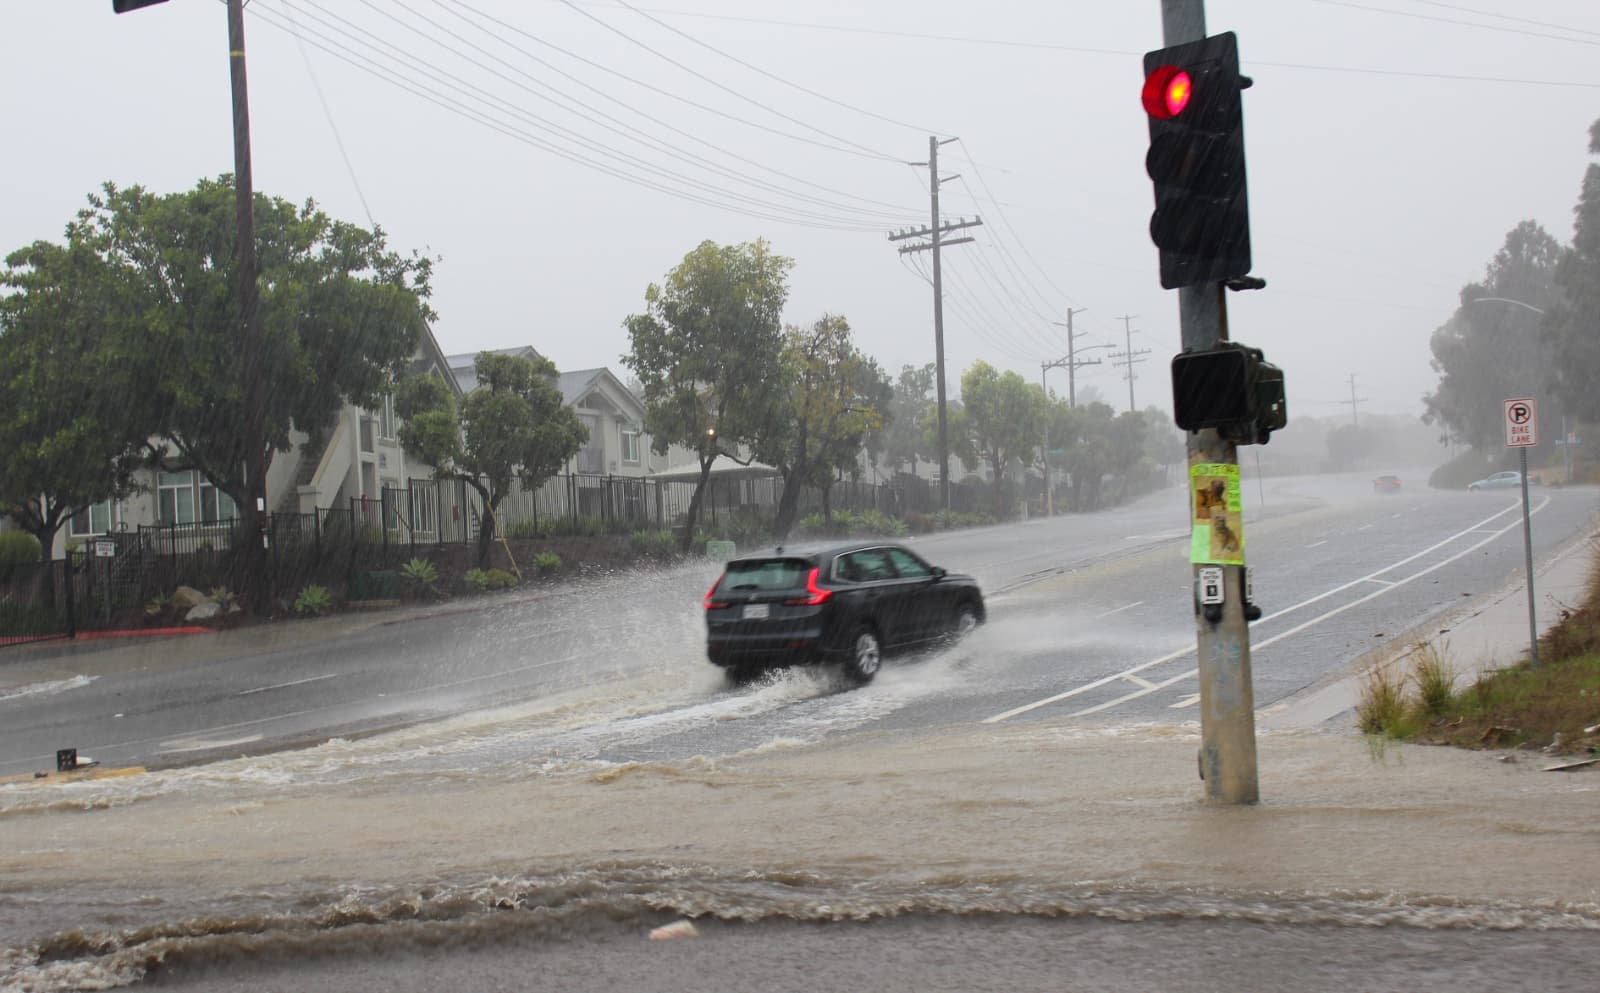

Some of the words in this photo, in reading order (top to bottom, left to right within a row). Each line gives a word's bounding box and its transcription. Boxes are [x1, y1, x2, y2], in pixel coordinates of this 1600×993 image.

[1515, 407, 1527, 421] P
[1511, 426, 1529, 434] BIKE
[1511, 435, 1530, 443] LANE
